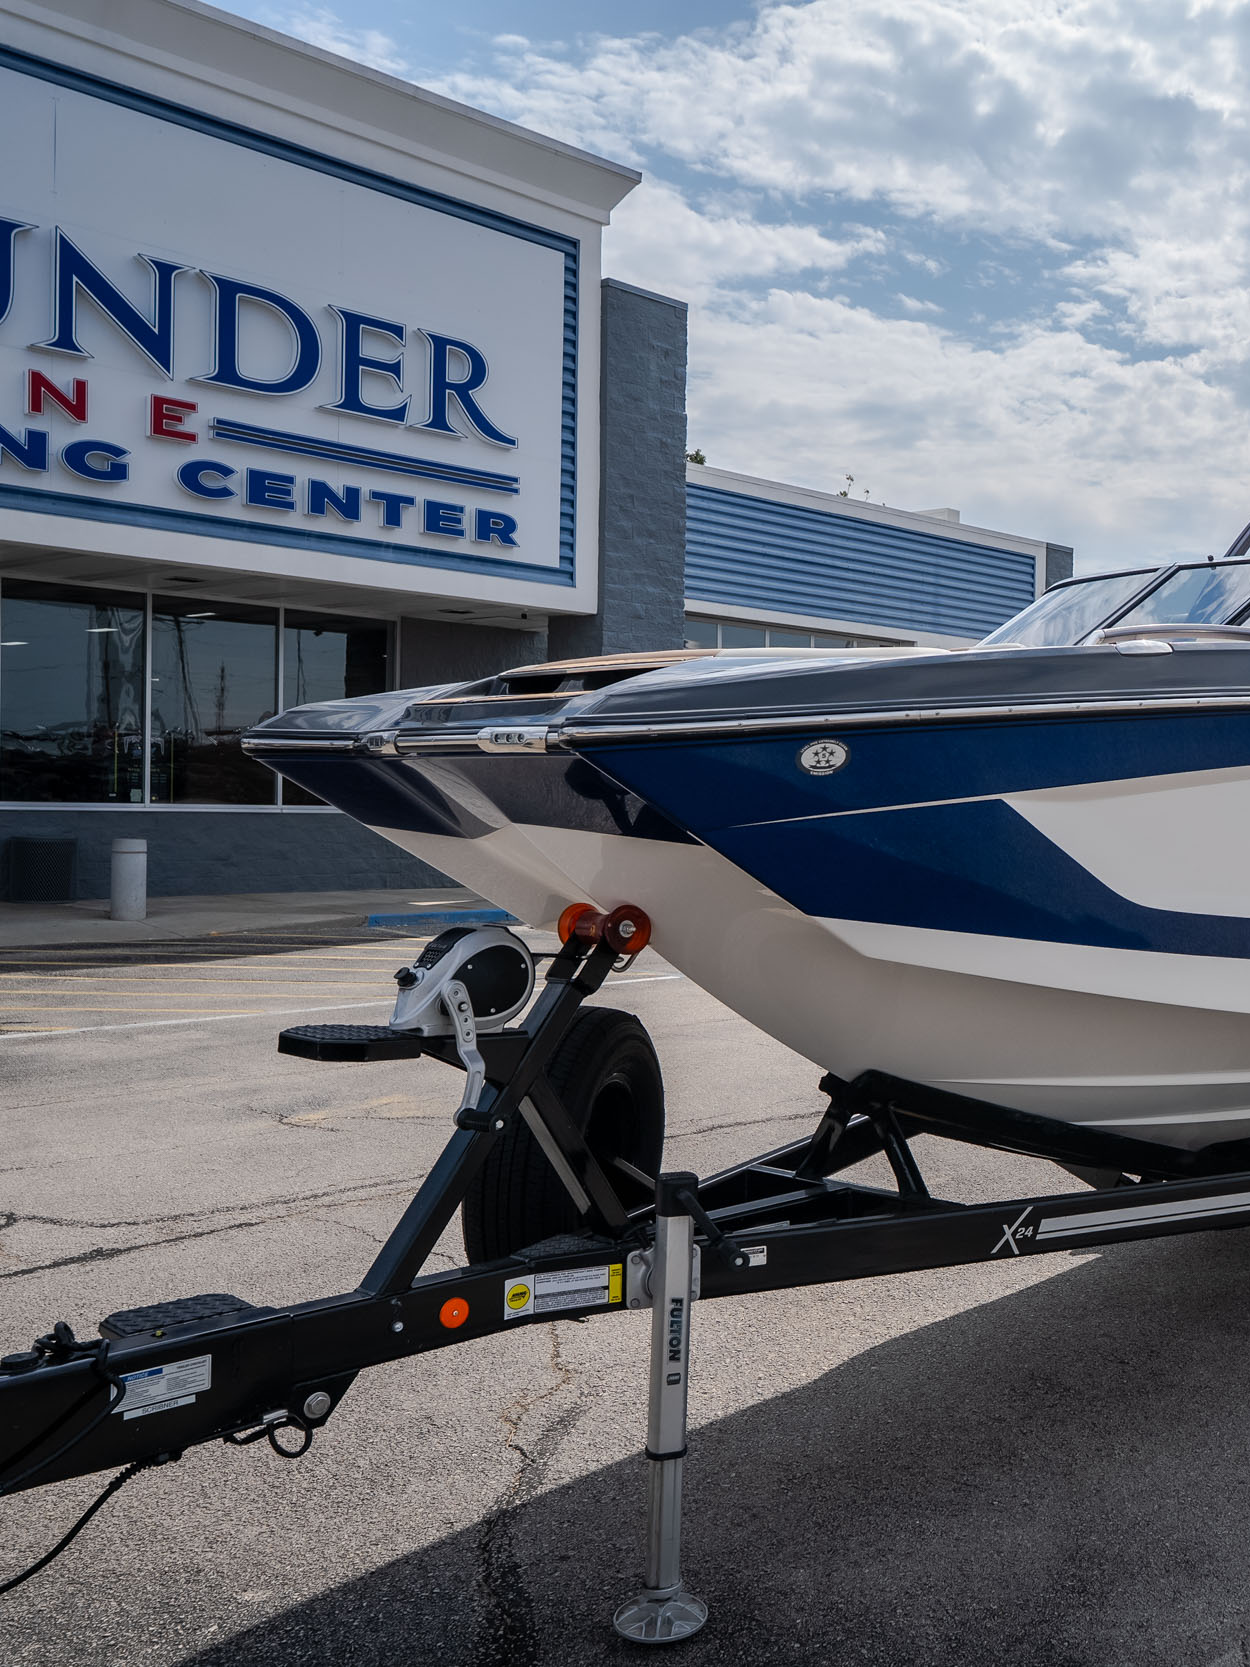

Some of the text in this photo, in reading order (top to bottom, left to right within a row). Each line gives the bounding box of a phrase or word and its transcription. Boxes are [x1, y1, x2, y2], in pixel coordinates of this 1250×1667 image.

[175, 458, 520, 548] CENTER
[668, 1296, 685, 1361] FULTON
[127, 1370, 149, 1381] NOTICE
[141, 1399, 179, 1415] SCRIBNER
